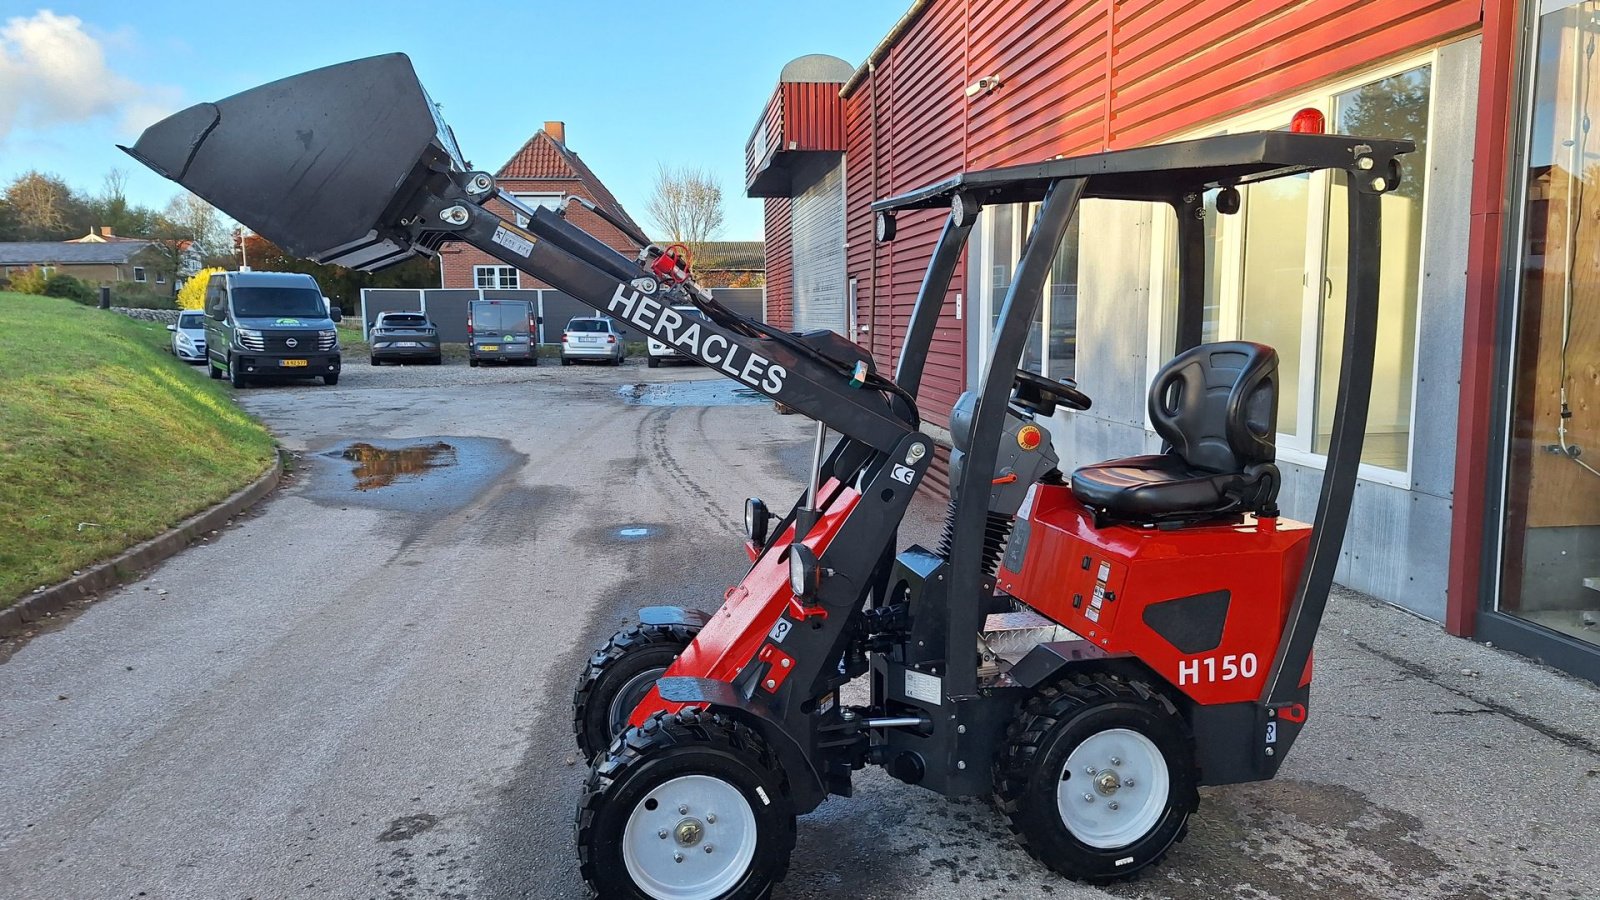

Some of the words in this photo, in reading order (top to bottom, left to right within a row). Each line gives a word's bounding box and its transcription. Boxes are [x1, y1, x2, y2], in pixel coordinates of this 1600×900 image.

[607, 283, 787, 394] HERACLES
[893, 466, 915, 484] CE
[1179, 652, 1258, 686] H150
